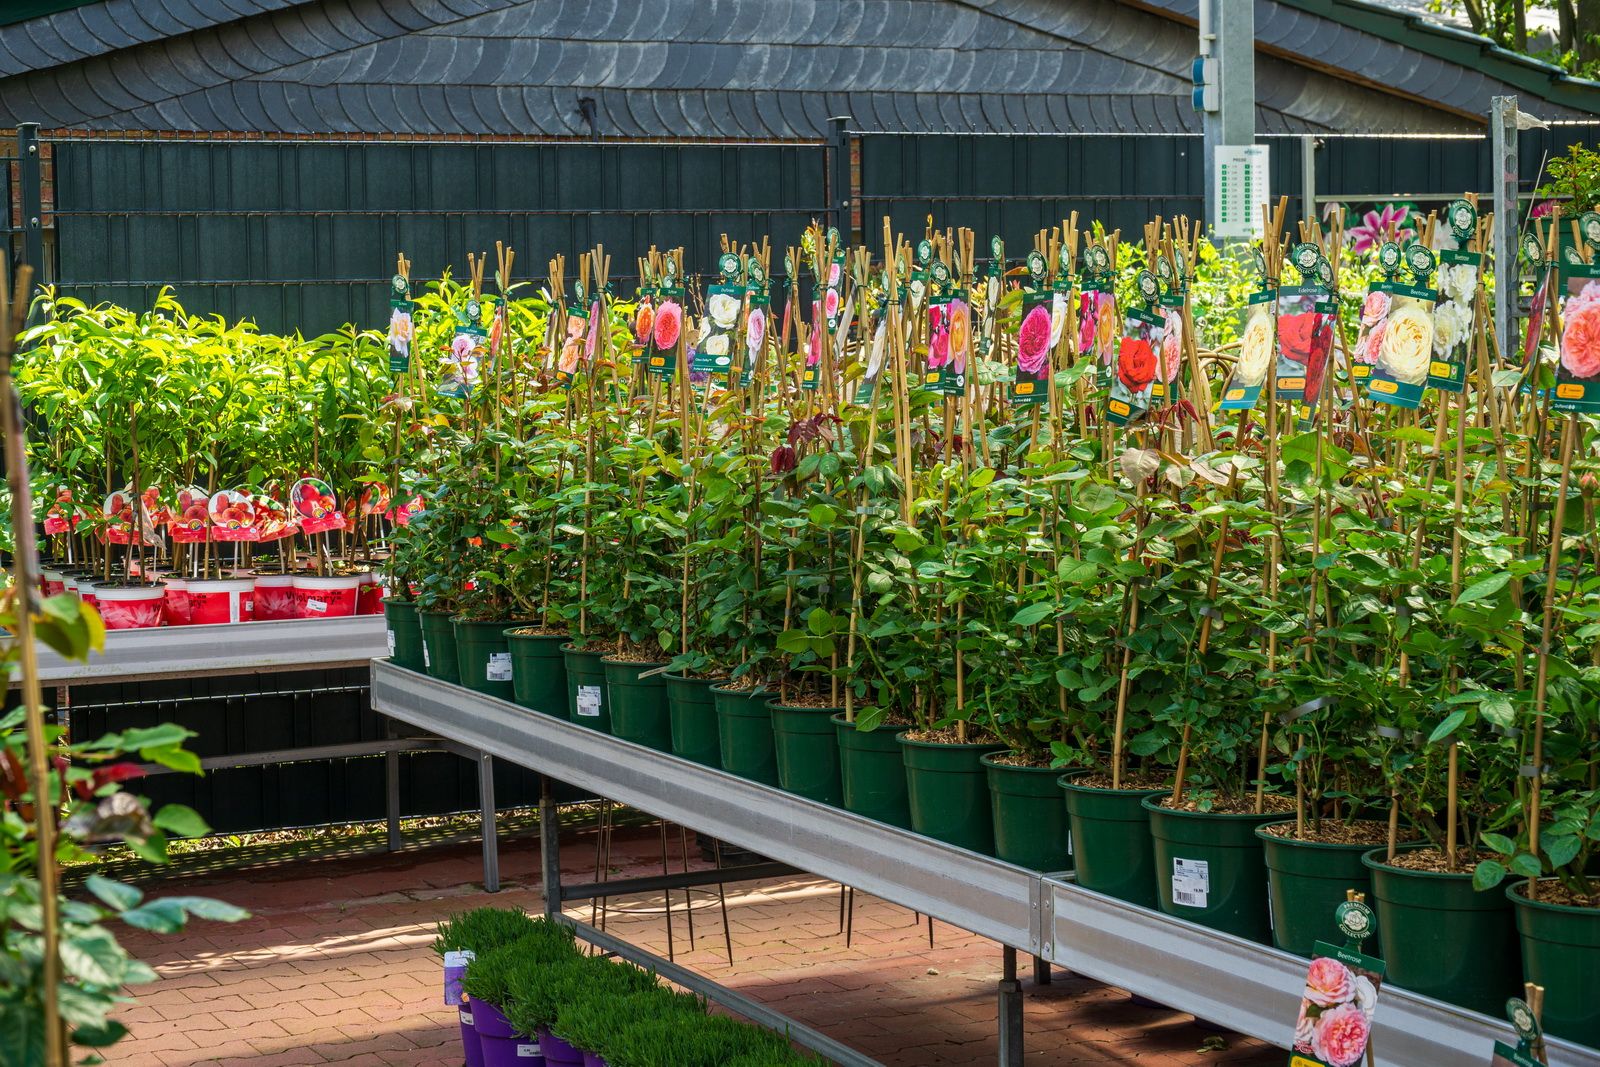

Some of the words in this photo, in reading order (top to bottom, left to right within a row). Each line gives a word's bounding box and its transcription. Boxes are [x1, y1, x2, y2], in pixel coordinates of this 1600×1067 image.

[1410, 288, 1429, 297] Beetrose
[1343, 902, 1370, 914] PREMIUM
[1338, 923, 1371, 939] COLLECTION
[1337, 950, 1362, 965] Beetrose
